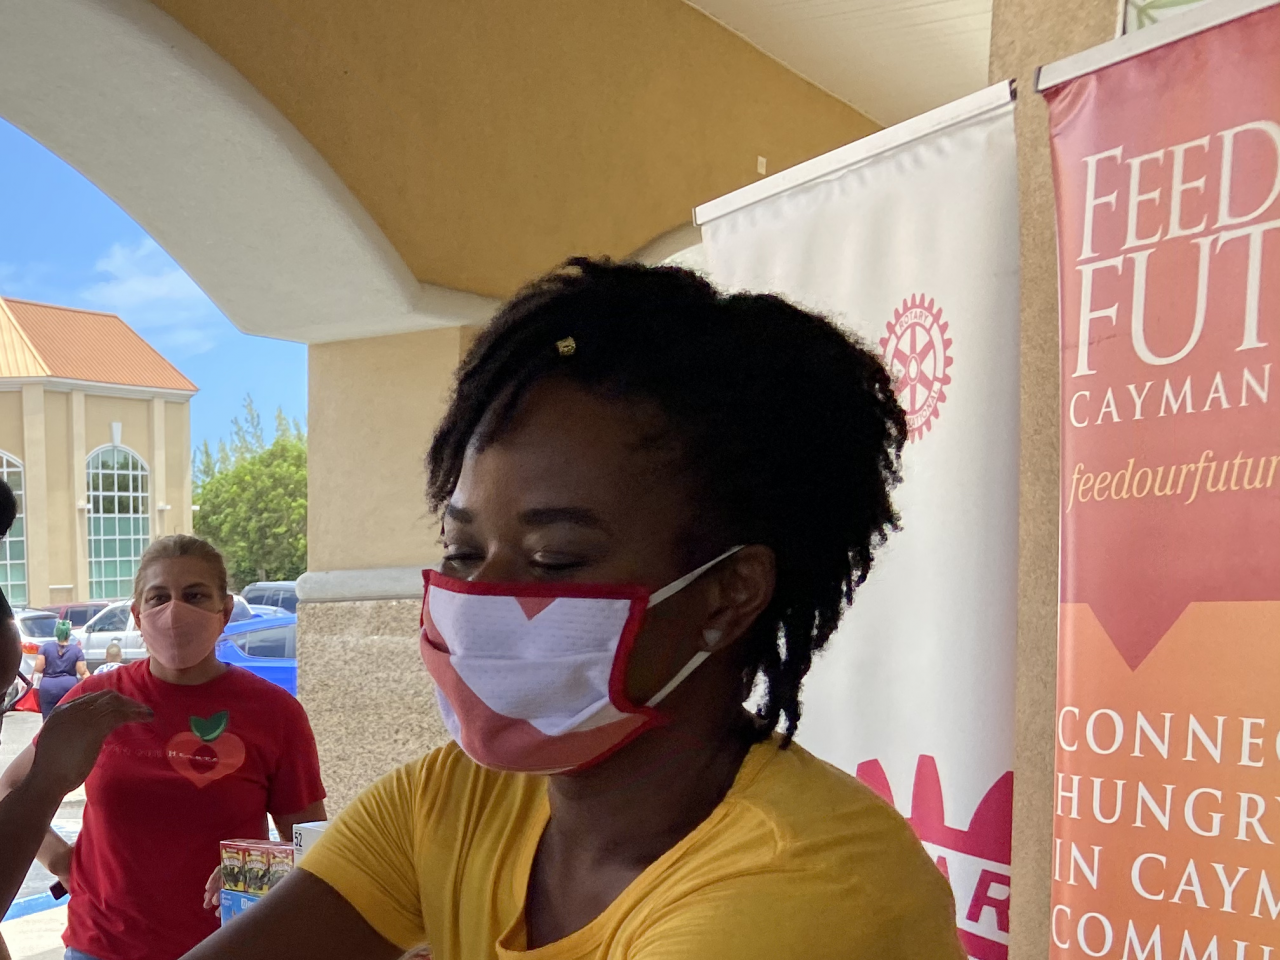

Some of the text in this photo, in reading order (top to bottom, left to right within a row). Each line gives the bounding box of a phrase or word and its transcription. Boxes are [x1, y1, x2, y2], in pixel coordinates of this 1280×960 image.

[1078, 120, 1280, 260] FEED
[899, 310, 929, 331] ROTARY
[908, 388, 939, 427] NATIONAL
[1069, 363, 1271, 427] CAYMAN
[1057, 705, 1280, 768] CONNE
[1055, 773, 1280, 845] HUNGR
[294, 831, 303, 848] 52
[1053, 839, 1103, 890] IN
